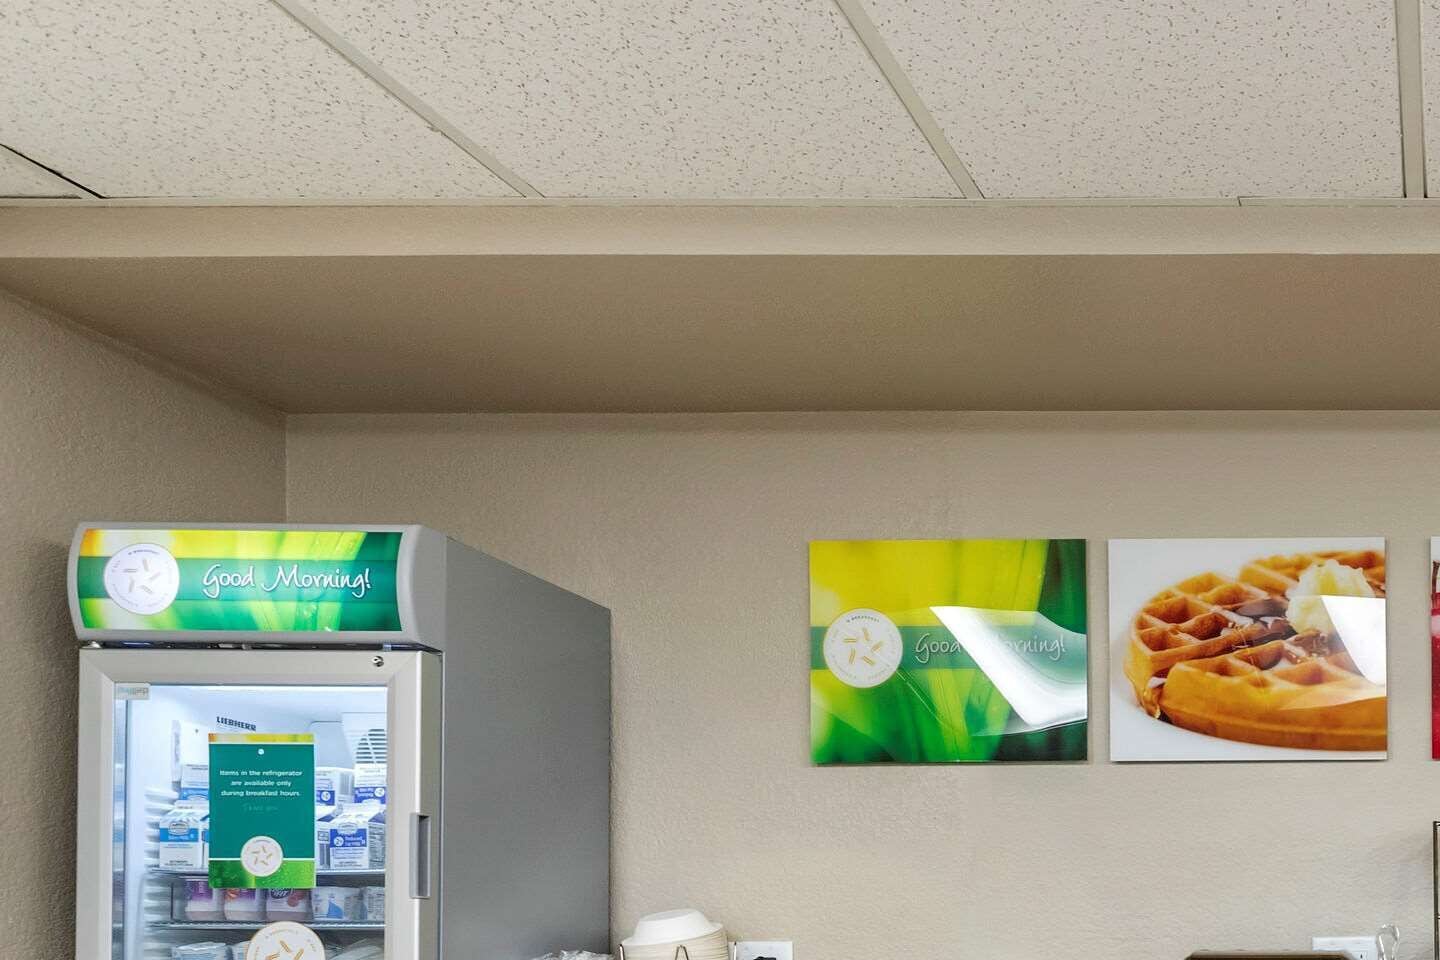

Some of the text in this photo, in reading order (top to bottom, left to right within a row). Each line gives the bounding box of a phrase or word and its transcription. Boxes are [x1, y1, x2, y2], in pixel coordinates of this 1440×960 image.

[203, 563, 255, 598] Good
[261, 563, 371, 598] Morning!
[216, 716, 257, 731] LIEBHERR
[262, 770, 303, 778] refrigerator
[276, 780, 292, 788] only
[221, 790, 244, 798] during
